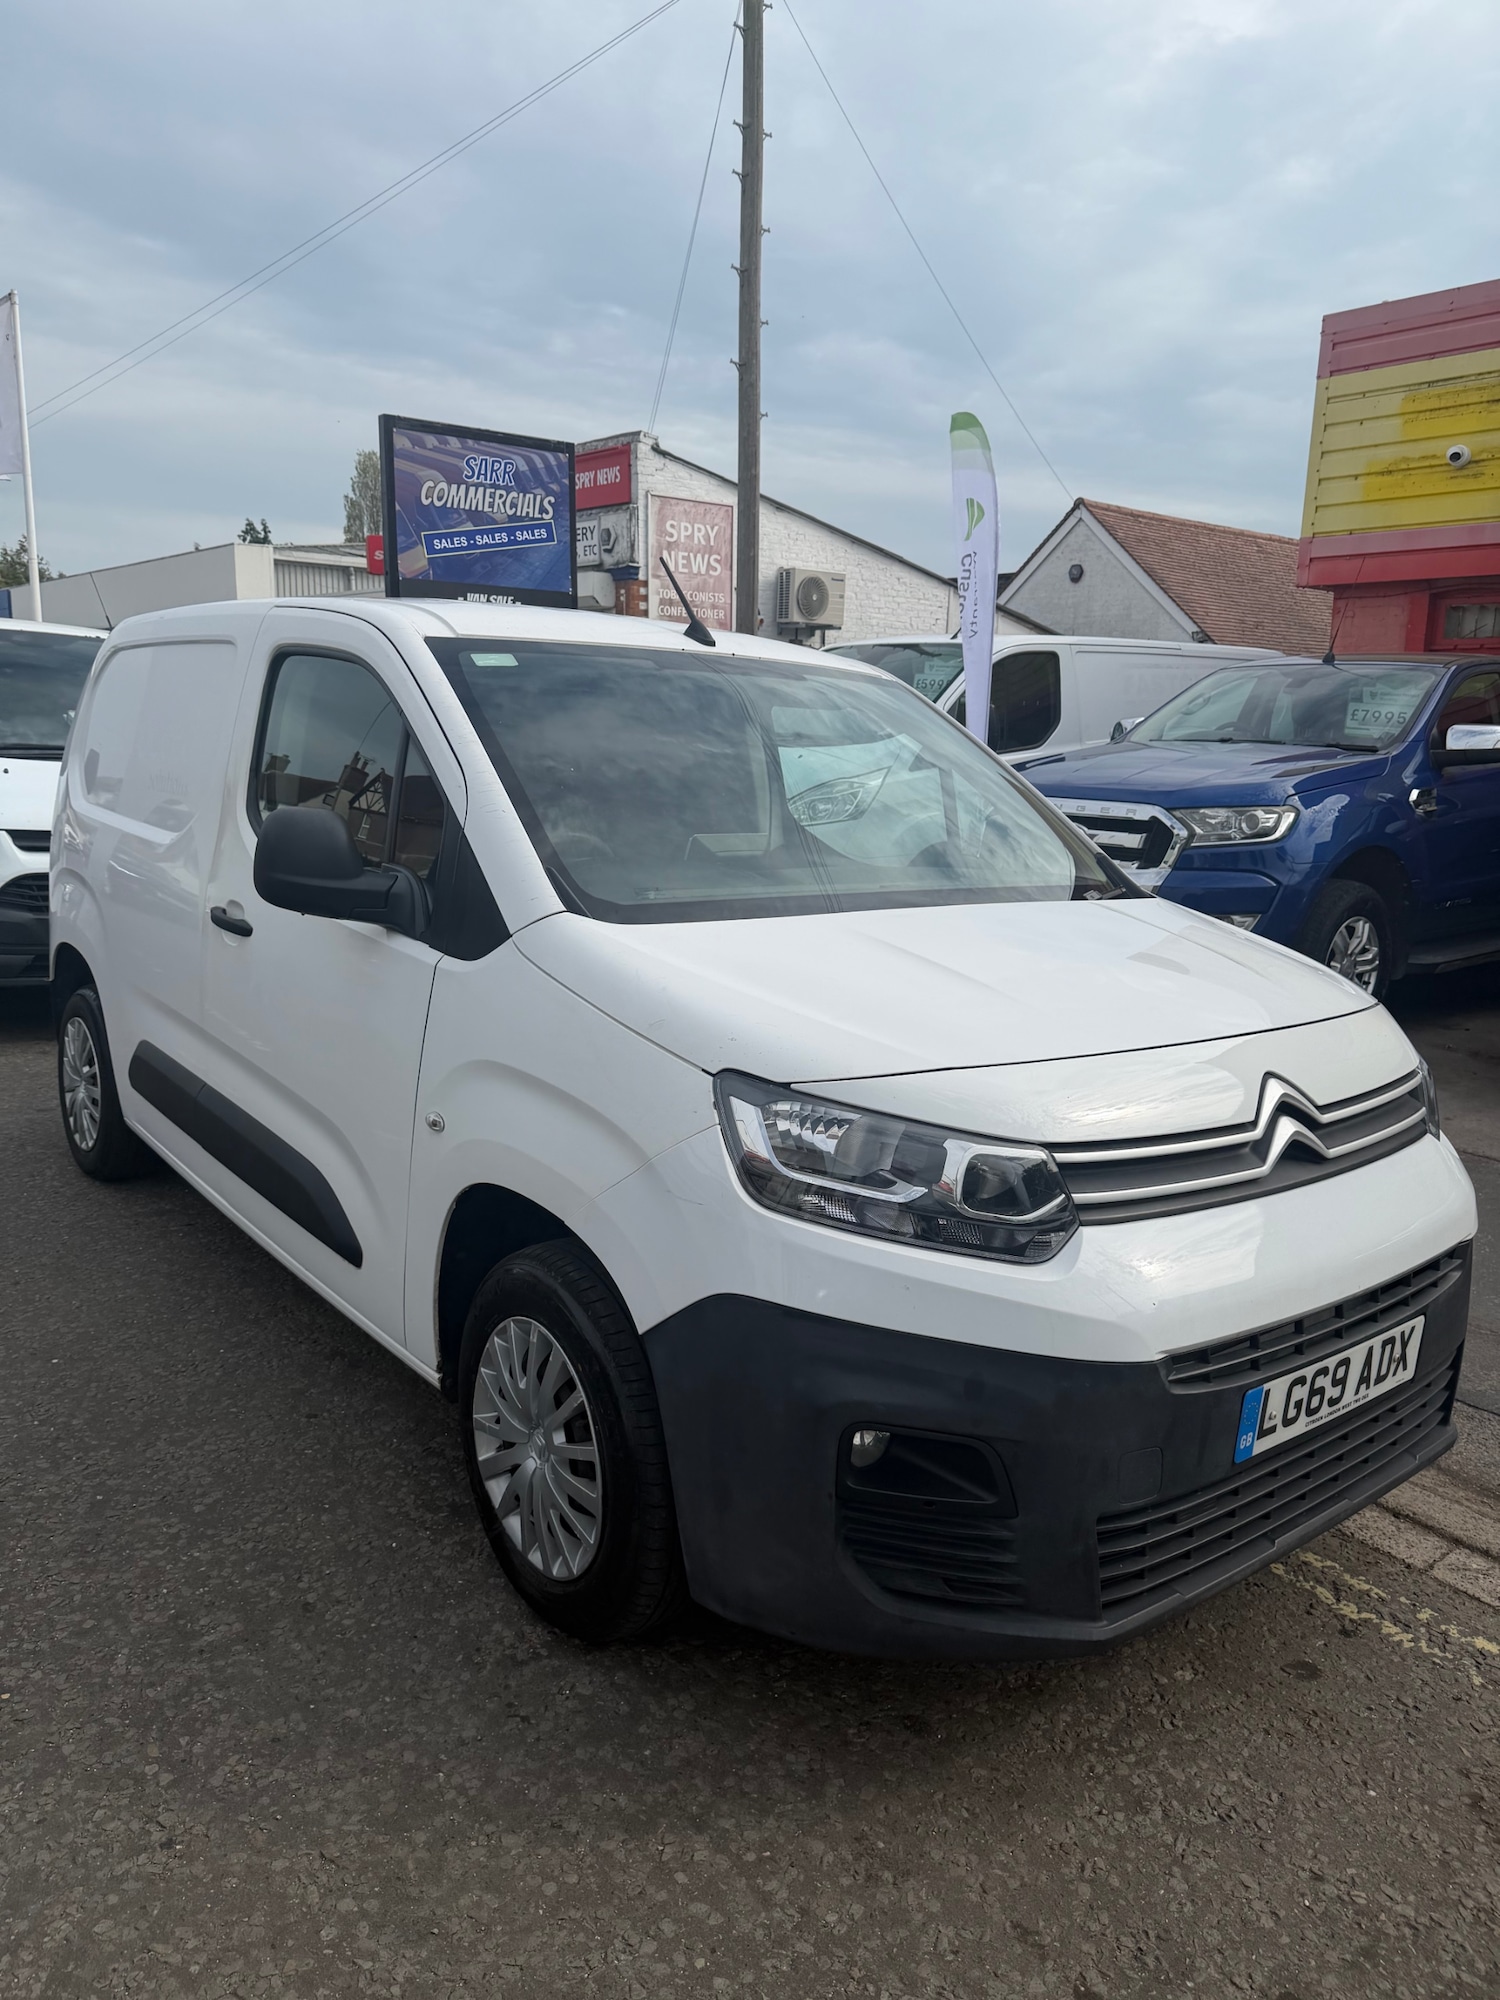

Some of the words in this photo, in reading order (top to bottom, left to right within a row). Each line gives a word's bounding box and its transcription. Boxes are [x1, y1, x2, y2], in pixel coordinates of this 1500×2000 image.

[463, 454, 516, 486] SARR
[575, 470, 596, 490] SPRY
[596, 466, 621, 486] NEWS
[421, 480, 556, 520] COMMERCIALS
[433, 536, 468, 550] SALES
[475, 532, 508, 546] SALES
[515, 528, 548, 541] SALES
[665, 520, 719, 546] SPRY
[583, 544, 598, 557] ETC
[662, 549, 722, 576] NEWS
[467, 592, 488, 603] VAN
[659, 588, 725, 604] TOBCONISTS
[658, 605, 726, 620] CONFETIONER
[1350, 708, 1408, 725] £7995
[1256, 1356, 1352, 1442] LG69
[1354, 1325, 1416, 1397] ADX
[1240, 1431, 1253, 1450] GB
